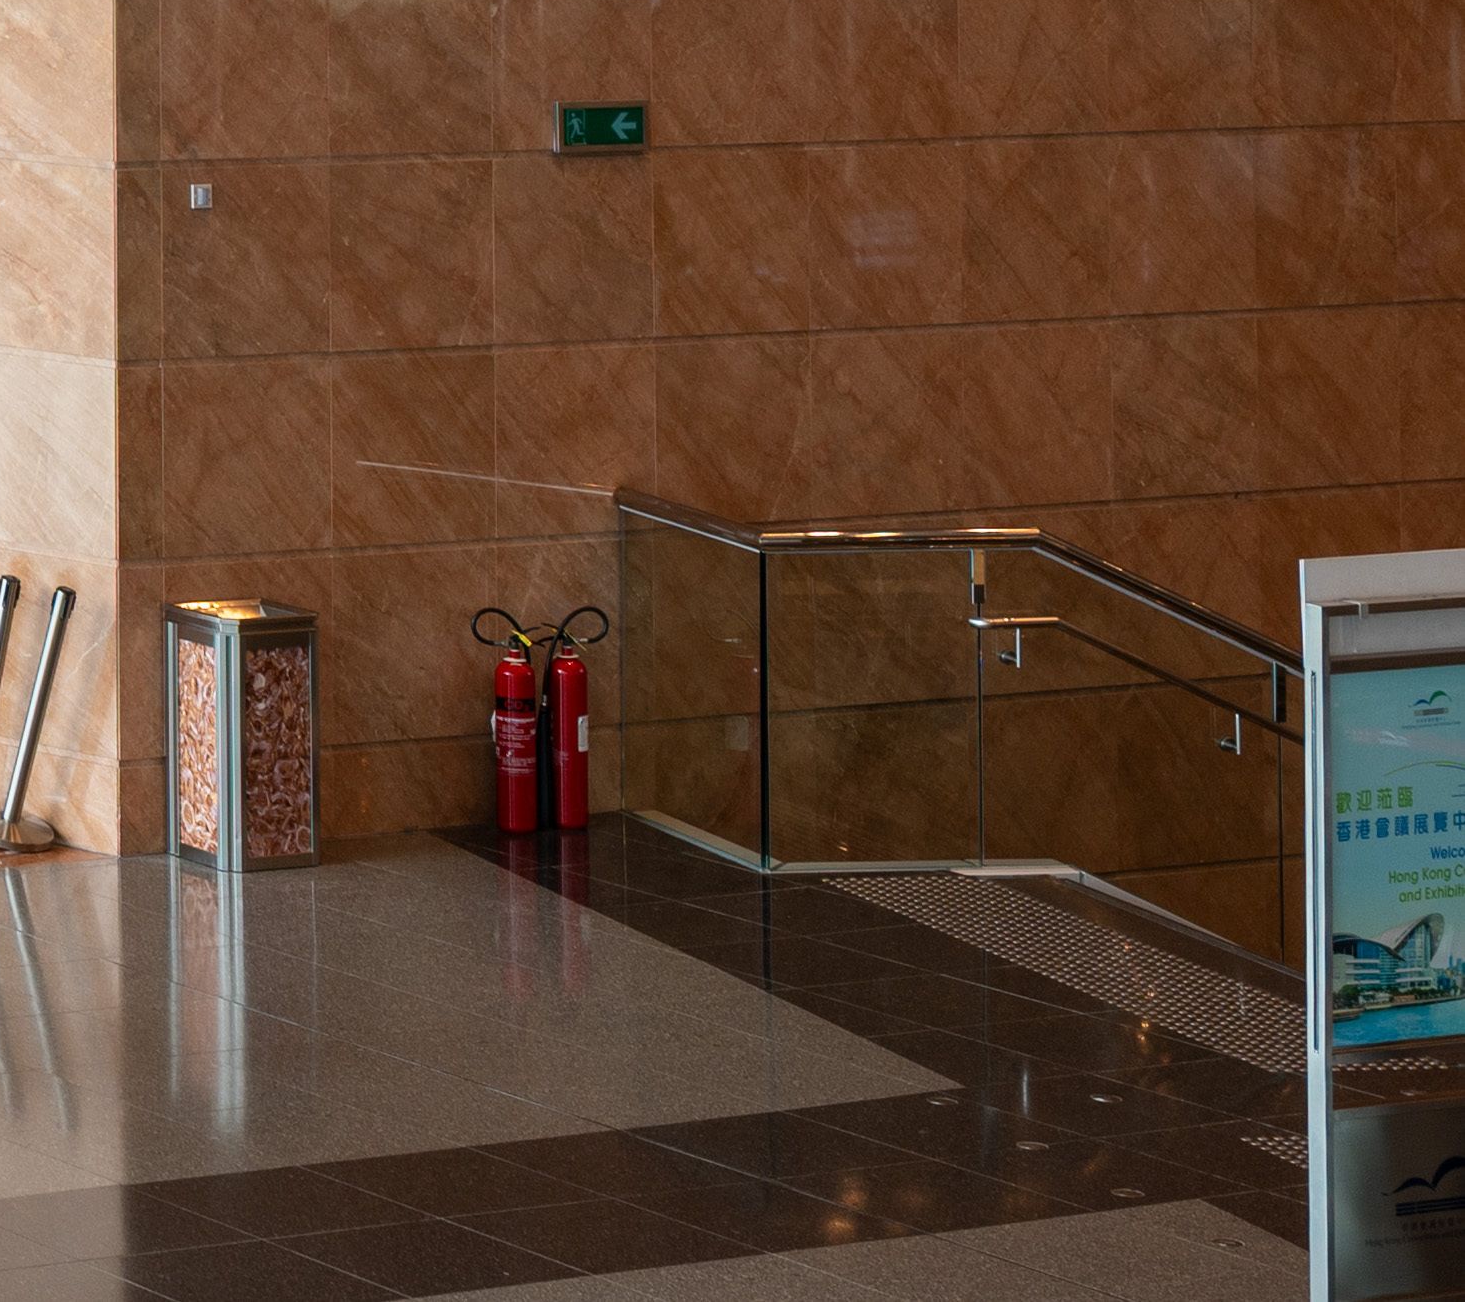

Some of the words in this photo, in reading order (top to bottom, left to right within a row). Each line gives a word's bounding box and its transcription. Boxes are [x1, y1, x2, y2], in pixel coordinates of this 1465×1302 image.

[1336, 786, 1413, 814] 歡迎蒞臨
[1389, 868, 1419, 885] Hong
[1422, 866, 1452, 882] Kong
[1399, 888, 1421, 903] and
